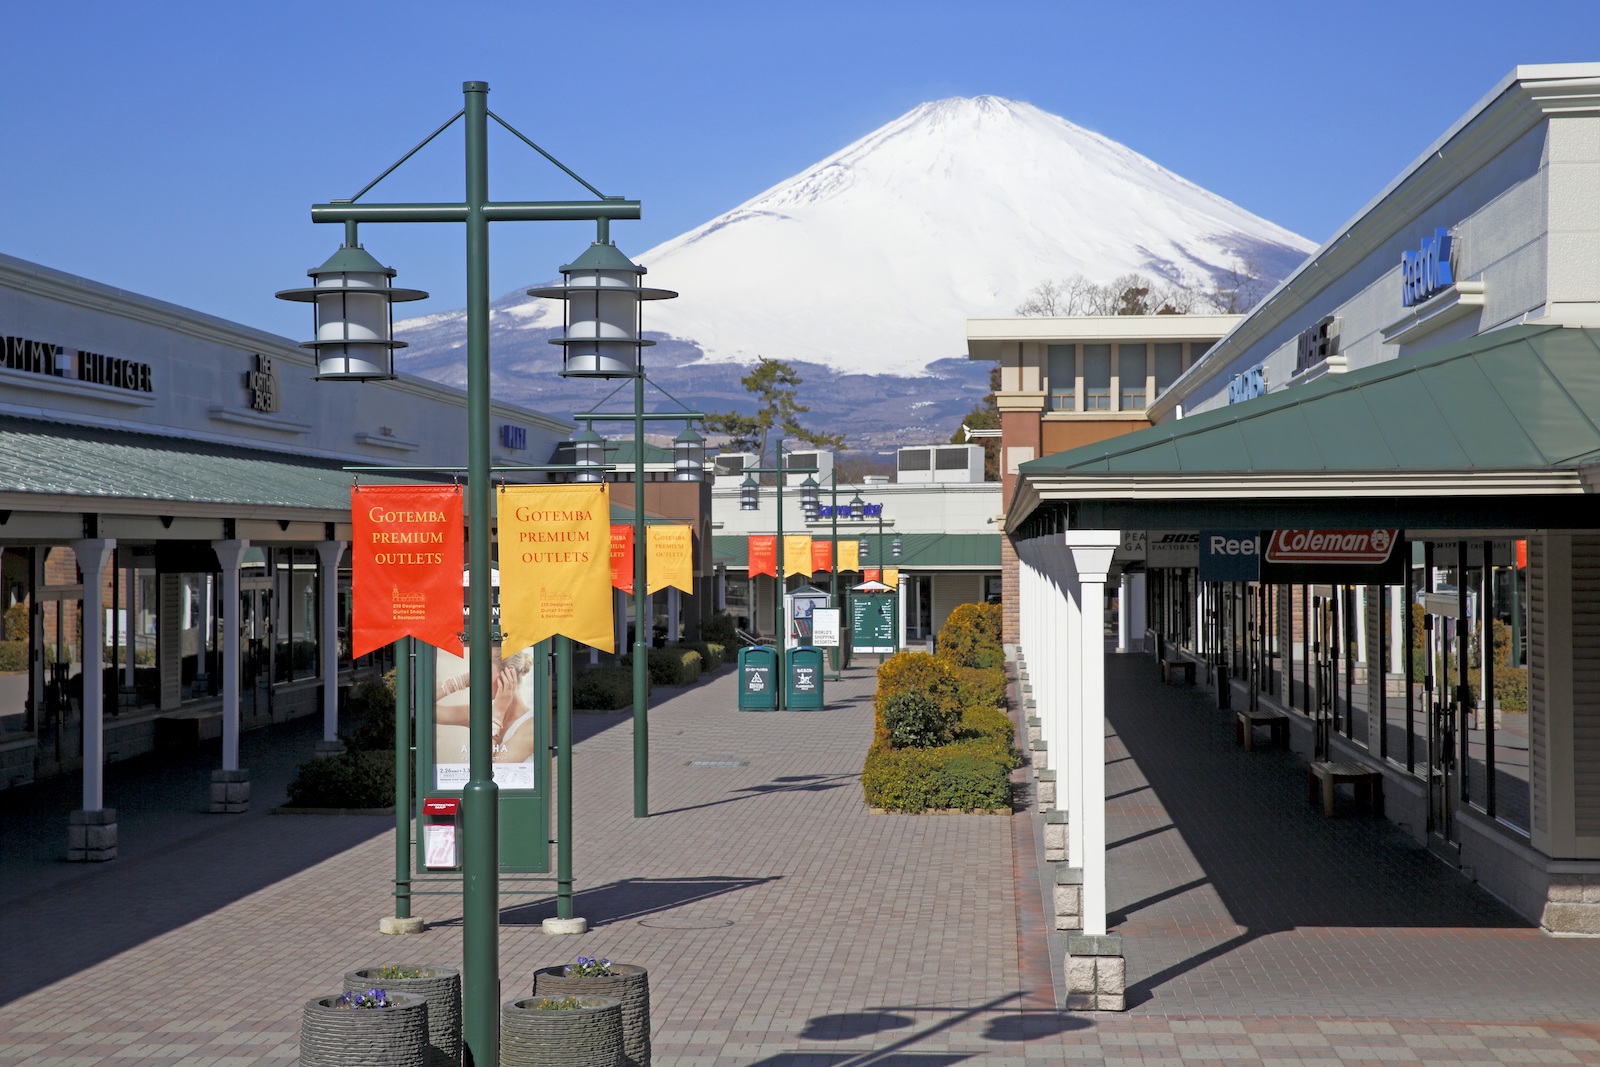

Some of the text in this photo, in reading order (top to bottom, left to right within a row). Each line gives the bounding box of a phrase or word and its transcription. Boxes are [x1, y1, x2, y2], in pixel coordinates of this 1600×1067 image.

[79, 350, 153, 392] HILFIGER
[257, 354, 271, 374] THE
[249, 371, 271, 393] NORTH
[253, 390, 272, 412] FACE
[369, 506, 447, 523] GOTEMBA
[515, 506, 593, 522] GOTEMBA
[372, 532, 444, 544] PREMIUM
[519, 531, 590, 542] PREMIUM
[1125, 533, 1147, 541] PEA
[1160, 534, 1199, 543] BOS
[1278, 530, 1369, 552] Coleman
[375, 552, 443, 565] OUTLETS
[522, 551, 589, 563] OUTLETS
